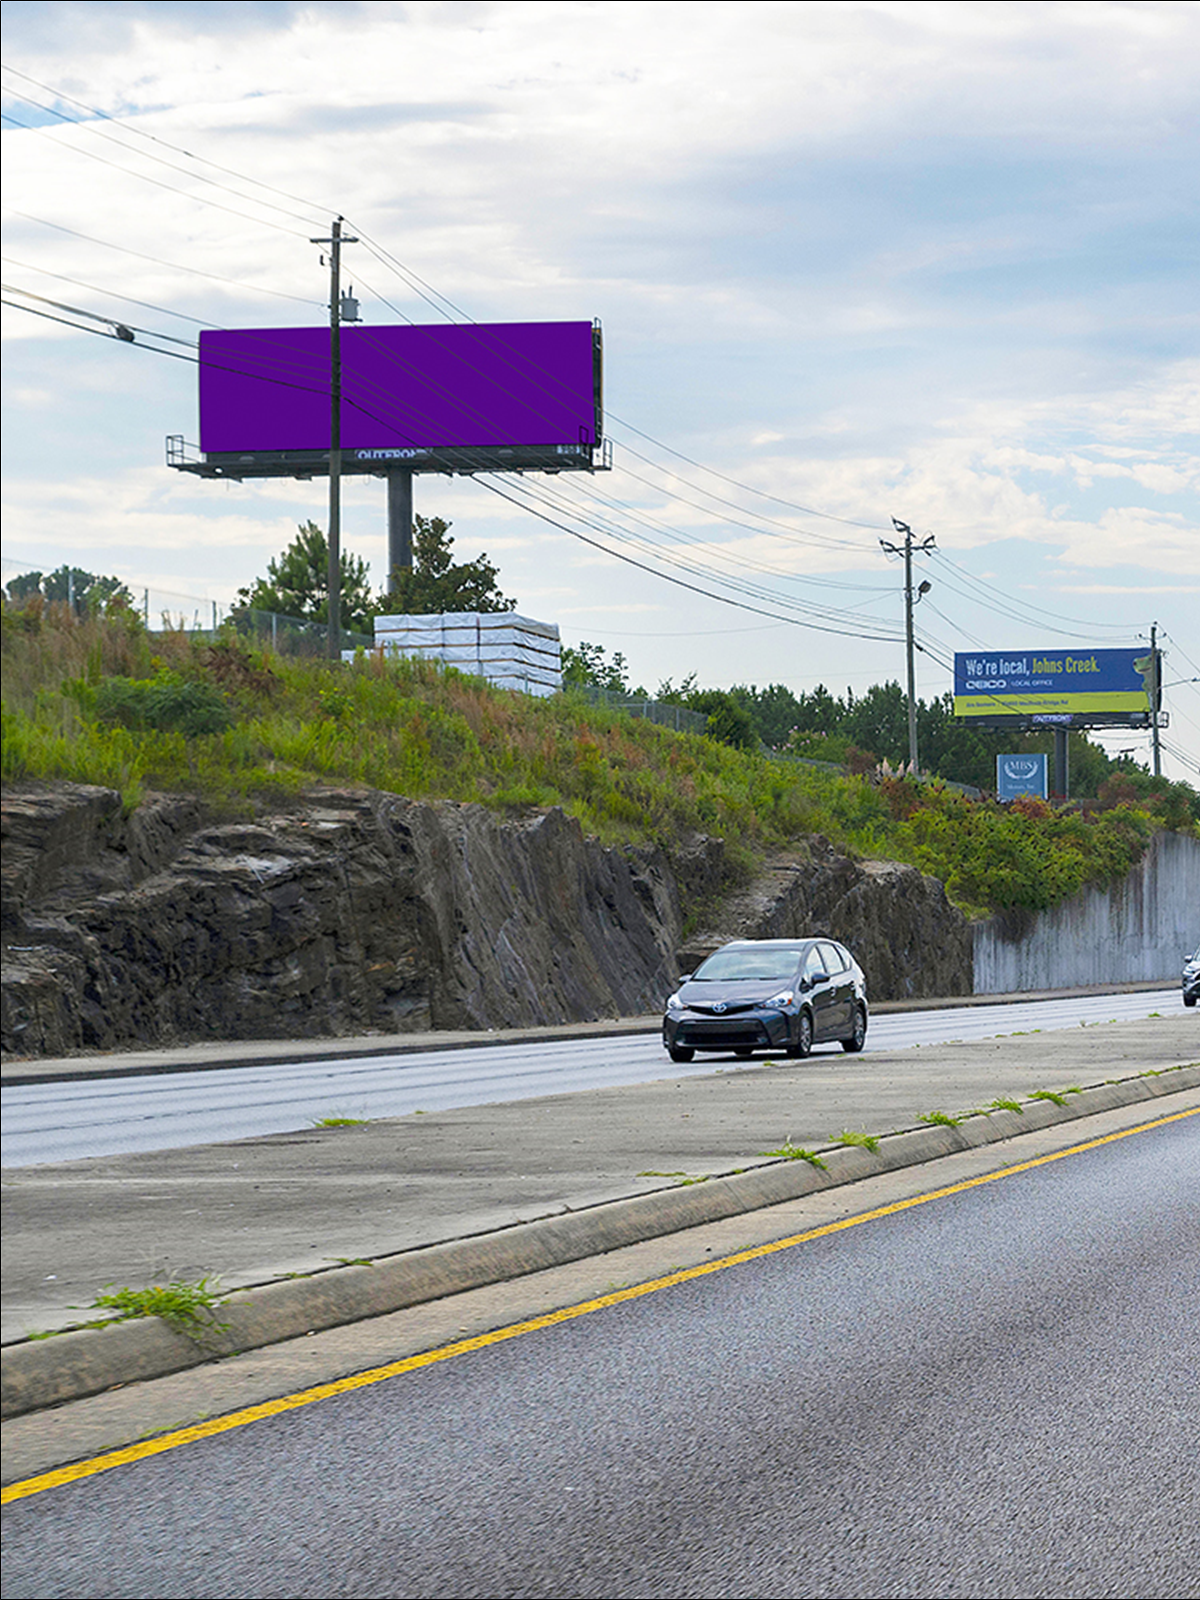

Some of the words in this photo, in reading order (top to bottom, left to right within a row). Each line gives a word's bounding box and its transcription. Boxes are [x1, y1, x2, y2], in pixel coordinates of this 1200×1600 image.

[965, 659, 999, 676] We're
[999, 658, 1030, 676] local,
[1032, 657, 1063, 674] Johns
[1065, 656, 1101, 673] Creek.
[965, 679, 1007, 690] GEICO
[1031, 679, 1053, 687] OFFICE
